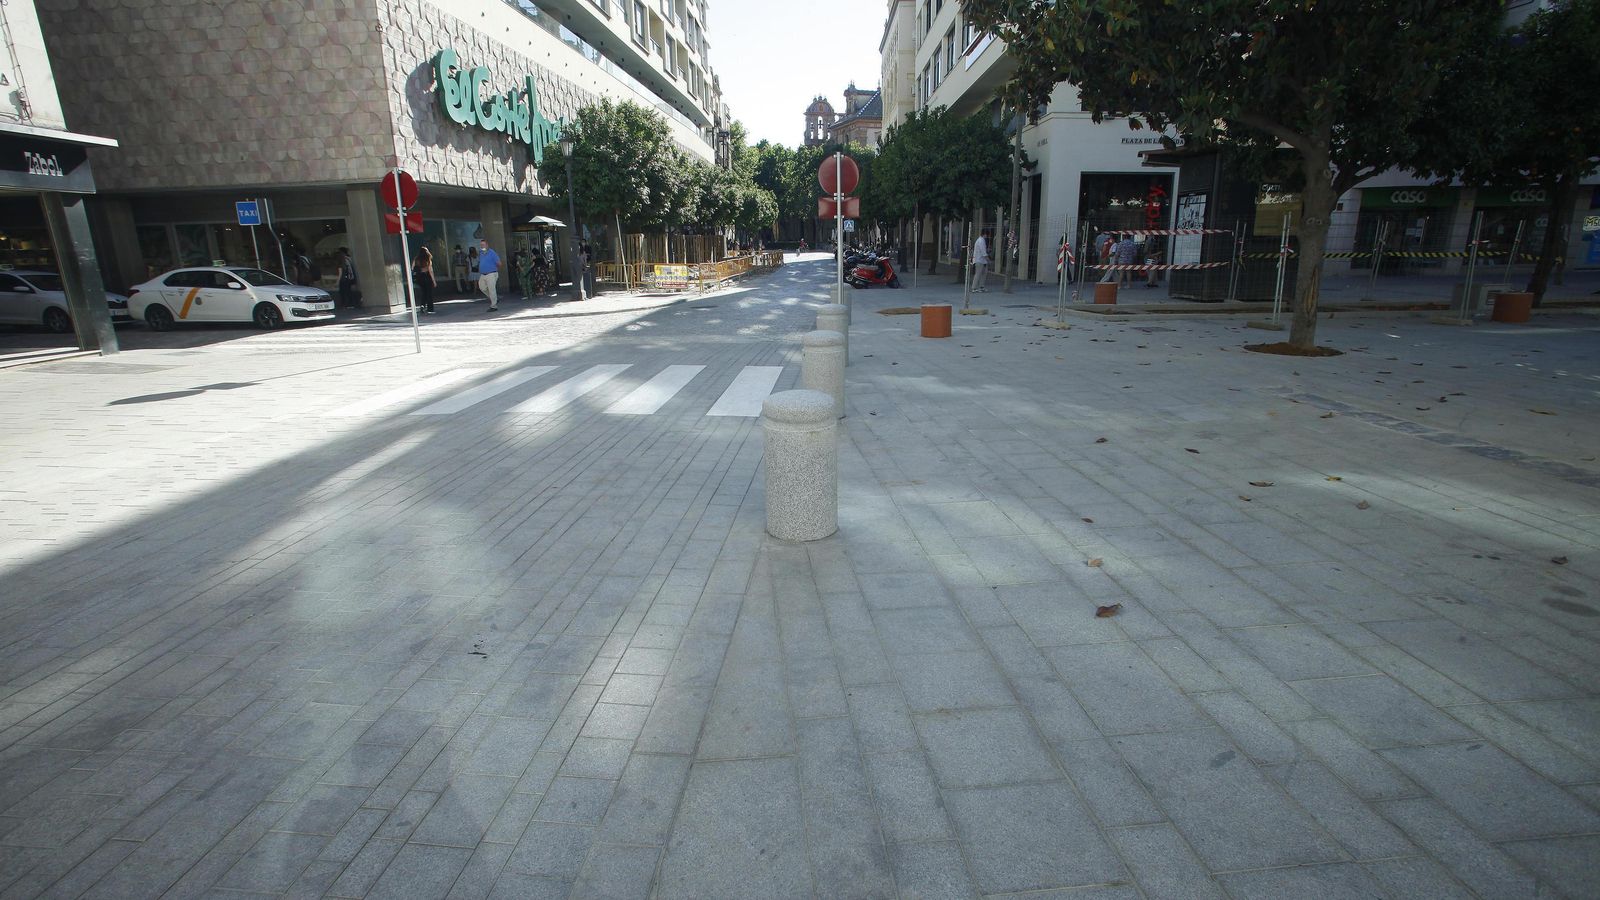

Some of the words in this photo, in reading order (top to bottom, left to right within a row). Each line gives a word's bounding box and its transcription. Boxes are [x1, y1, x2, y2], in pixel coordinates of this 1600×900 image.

[436, 48, 476, 126] El
[473, 66, 532, 144] Corte
[239, 209, 258, 217] TAXI
